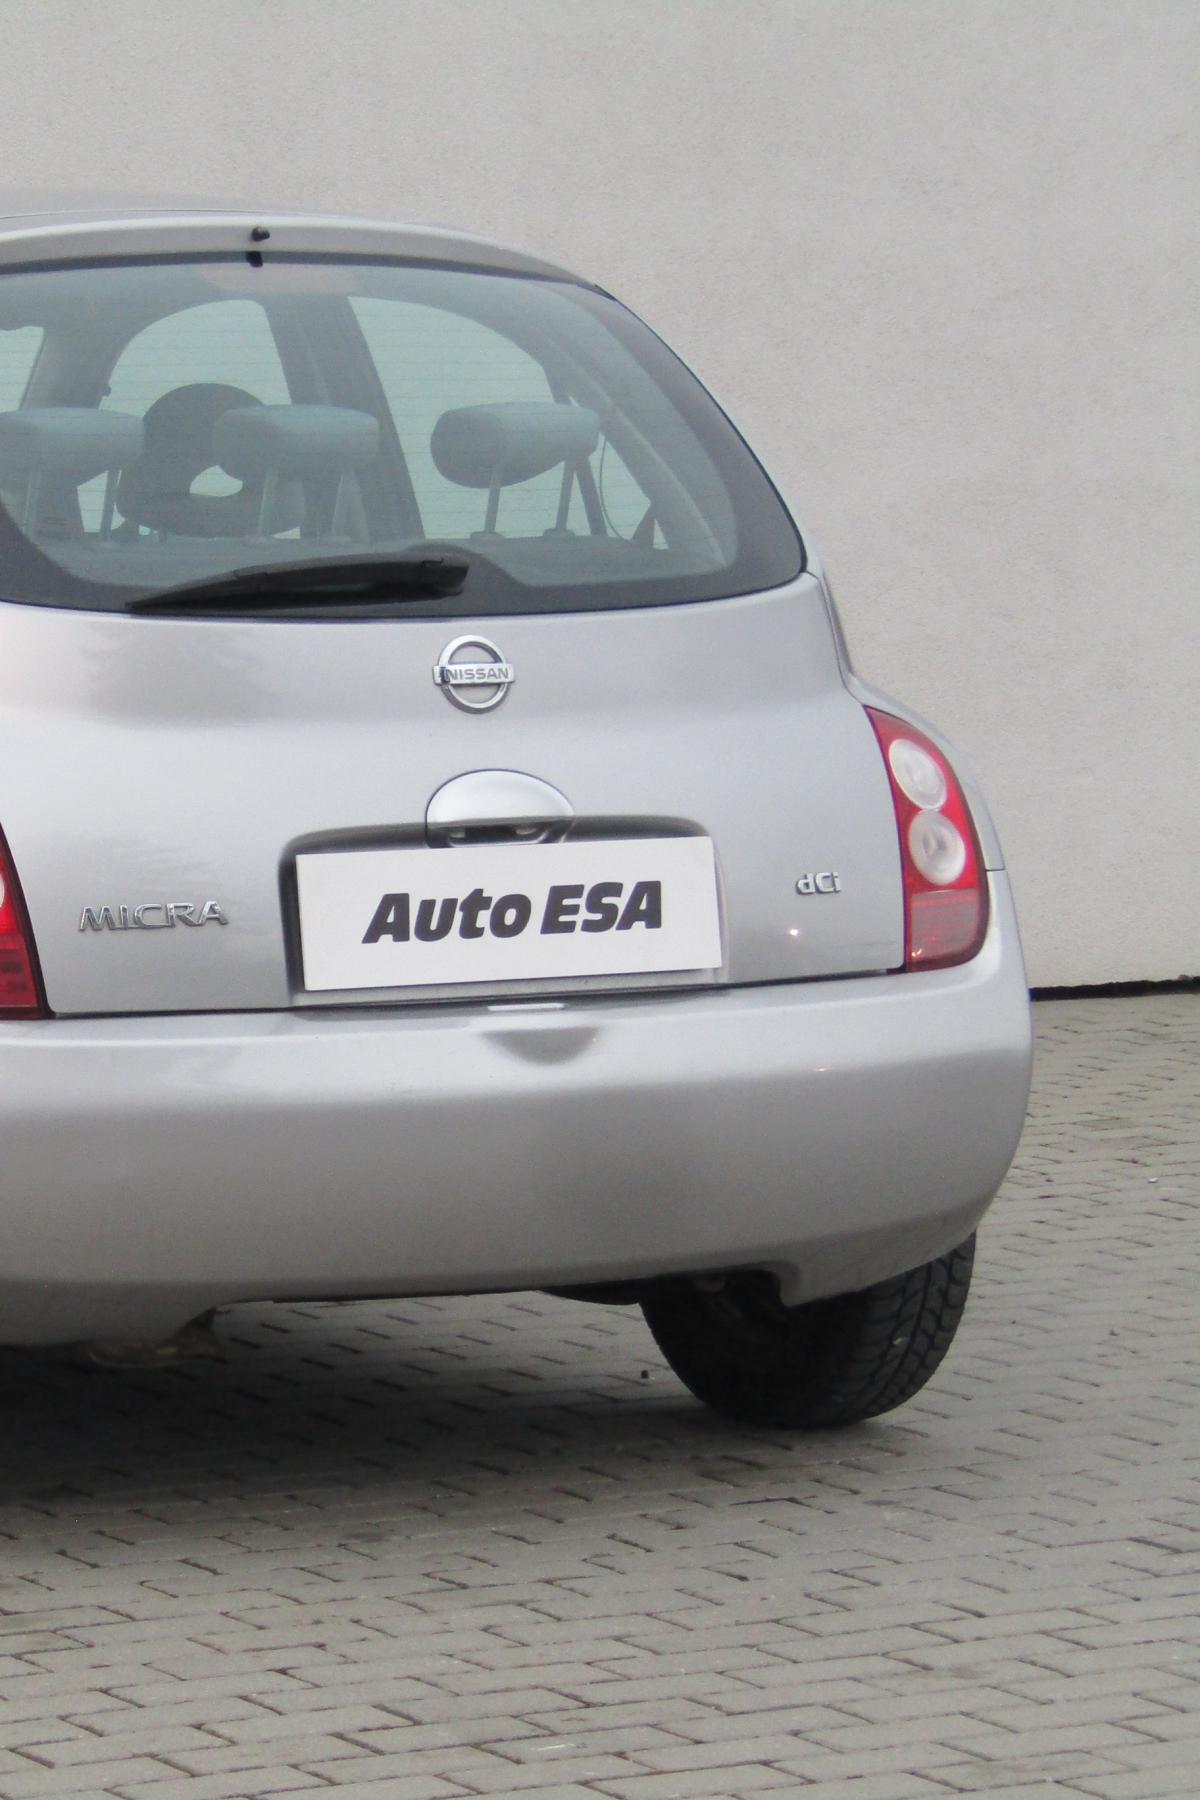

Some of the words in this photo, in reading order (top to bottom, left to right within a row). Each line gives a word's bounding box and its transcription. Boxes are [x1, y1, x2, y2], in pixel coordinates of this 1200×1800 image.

[445, 667, 509, 681] NISSAN
[796, 872, 841, 894] dCi
[79, 901, 229, 931] MICRA
[362, 888, 531, 944] Auto
[540, 880, 662, 936] ESA
